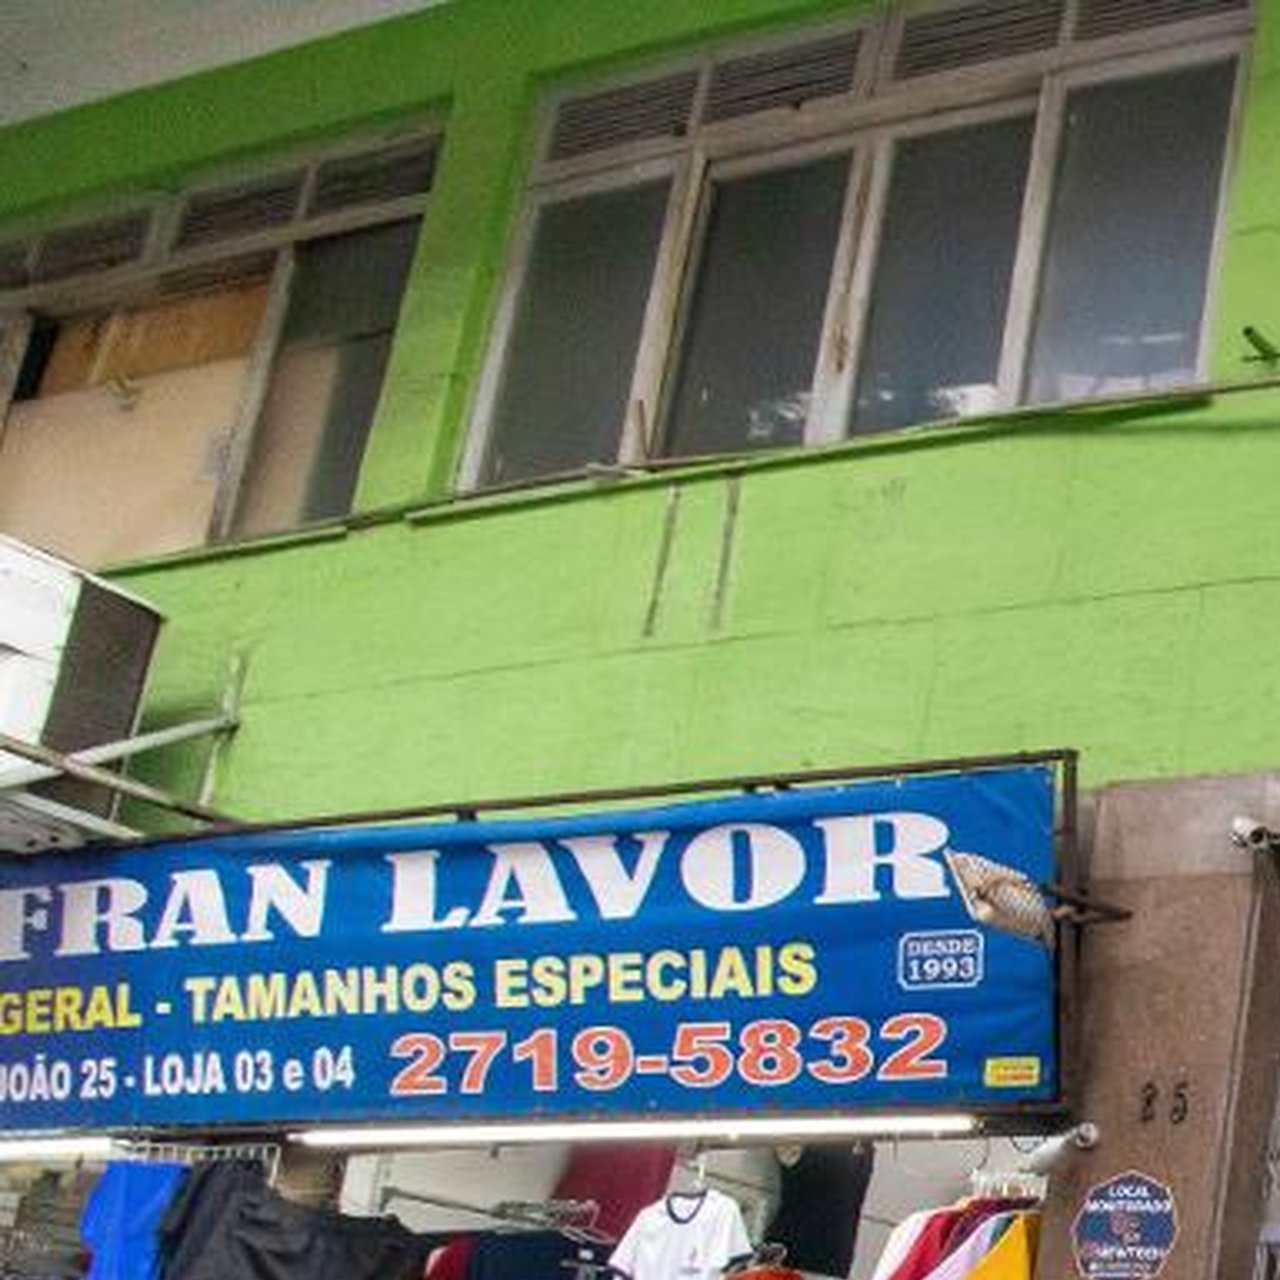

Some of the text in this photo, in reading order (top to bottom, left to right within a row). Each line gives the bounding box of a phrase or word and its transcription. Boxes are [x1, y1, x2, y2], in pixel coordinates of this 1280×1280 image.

[0, 811, 951, 962] FRAN LAVOR
[906, 935, 977, 956] DESDE
[908, 956, 977, 981] 1993
[0, 983, 142, 1035] GERAL
[186, 960, 477, 1023] TAMANHOS
[495, 943, 818, 1009] ESPECIAIS
[82, 1058, 117, 1097] 25
[144, 1050, 226, 1096] LOJA
[235, 1048, 272, 1093] 03
[282, 1063, 304, 1090] e
[313, 1045, 355, 1090] 04
[389, 1012, 949, 1097] 2719-5832
[1108, 1185, 1151, 1198] LOCAL
